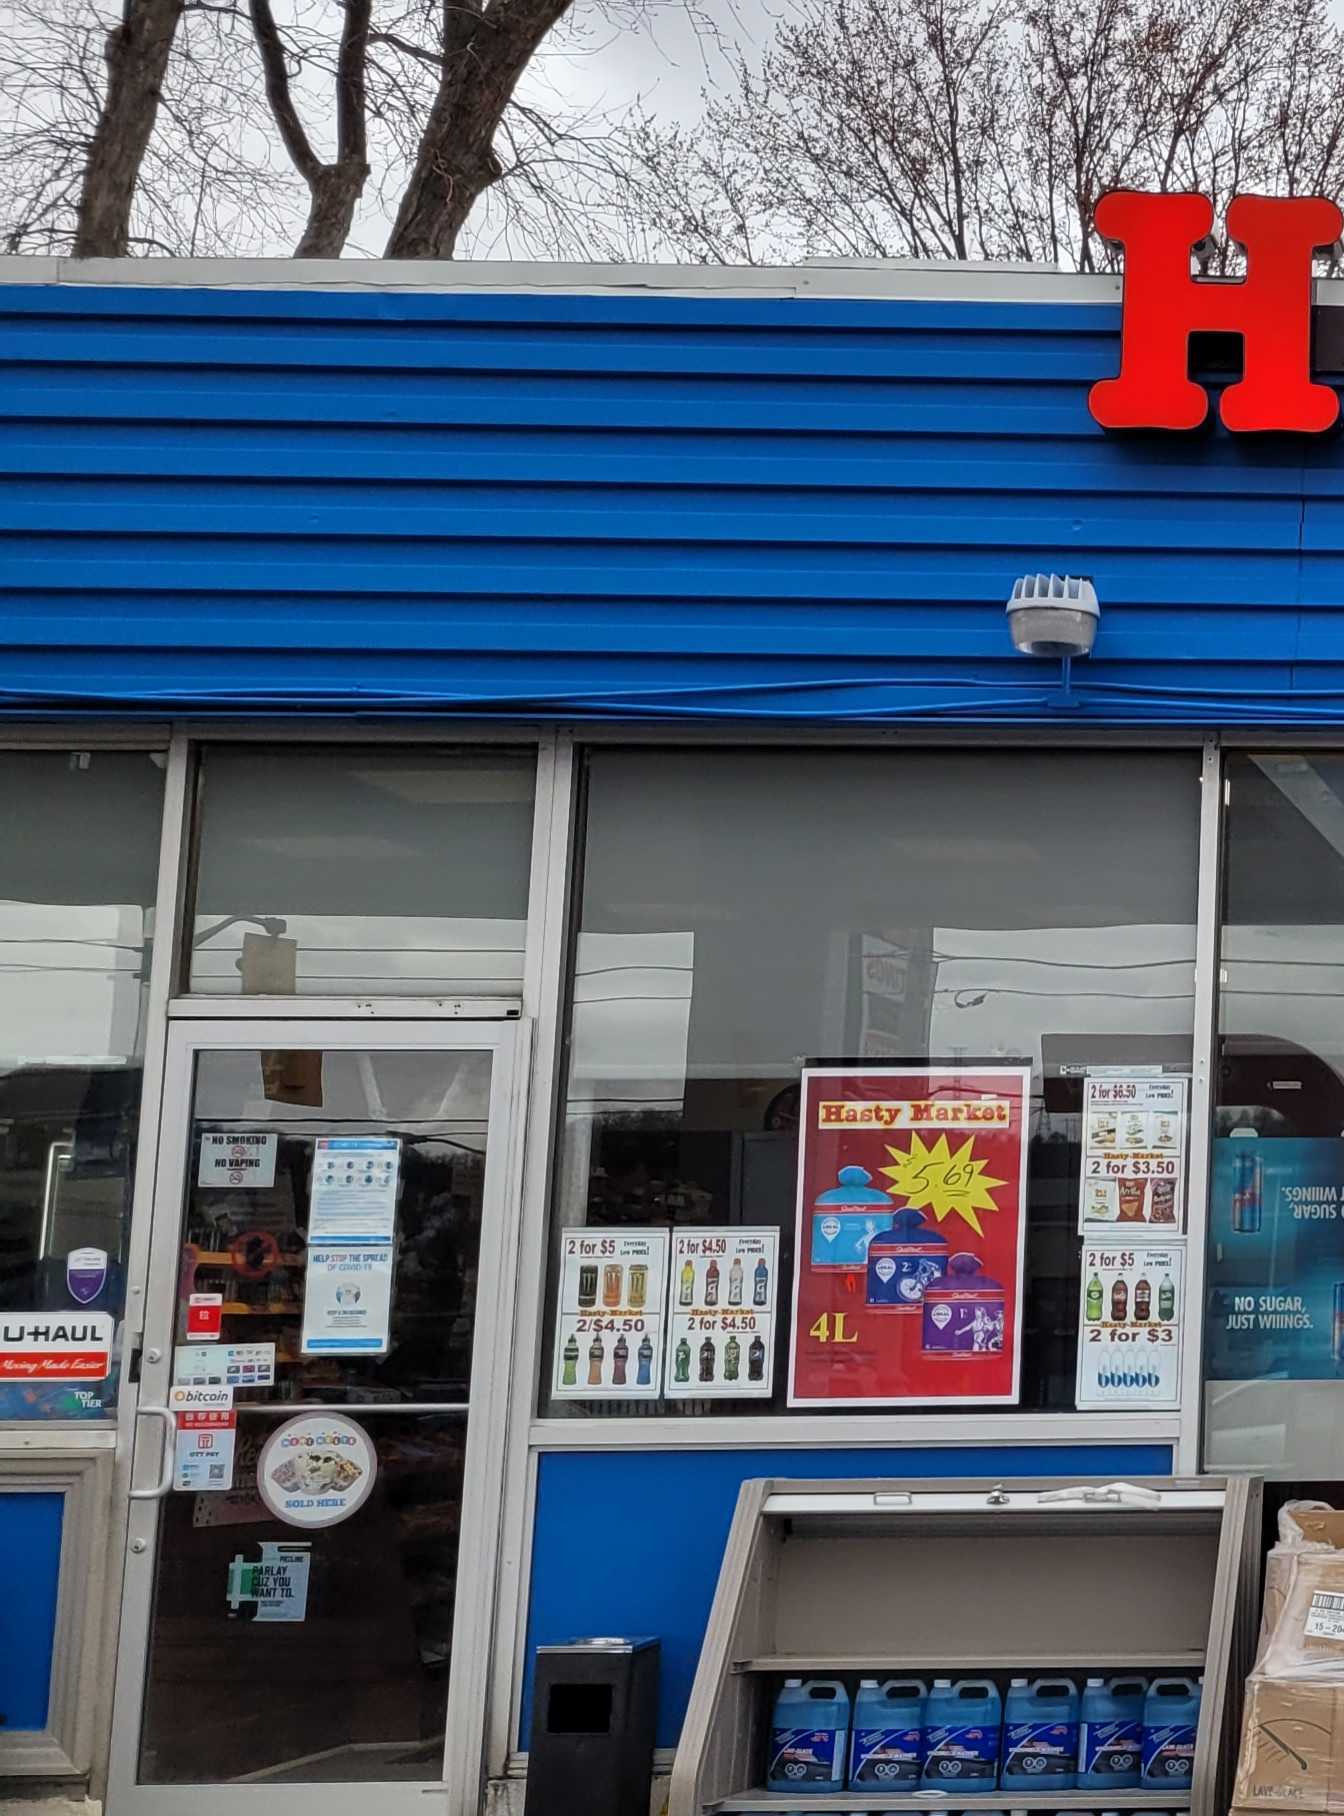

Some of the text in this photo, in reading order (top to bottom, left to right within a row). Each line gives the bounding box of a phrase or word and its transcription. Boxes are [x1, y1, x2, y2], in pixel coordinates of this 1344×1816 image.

[1090, 1086, 1096, 1099] 2
[1098, 1085, 1110, 1098] for
[822, 1103, 1006, 1126] Hasty Market
[212, 1136, 267, 1145] NO SMOKING
[215, 1158, 261, 1168] NO VAPING
[1091, 1161, 1175, 1175] 2 for $3.50
[1289, 1204, 1337, 1219] SUGAR,
[568, 1239, 615, 1255] 2 for $5
[679, 1239, 726, 1255] 2 for $4.50
[313, 1254, 389, 1263] HELP STOP THE SPREAD
[1089, 1252, 1135, 1269] 2 for $5
[328, 1263, 337, 1272] OF
[1234, 1297, 1307, 1313] NO SUGAR,
[579, 1309, 609, 1317] Hasty
[691, 1309, 720, 1317] Hasty
[576, 1319, 645, 1332] 2/$4.50
[688, 1316, 756, 1331] 2 for $4.50
[810, 1312, 858, 1343] 4L
[1226, 1315, 1314, 1329] JUST WIIINGS.
[3, 1325, 103, 1342] U-HAUL
[1089, 1328, 1173, 1344] 2 for $3
[3, 1357, 105, 1374] Moving Made Easier
[74, 1391, 94, 1400] TOP
[185, 1390, 229, 1403] bitcoin
[81, 1399, 102, 1409] TIER
[284, 1498, 347, 1509] SOLD HERE
[253, 1566, 288, 1576] PARLAY
[252, 1577, 291, 1587] CUZ YOU
[252, 1588, 295, 1599] WANT TO.
